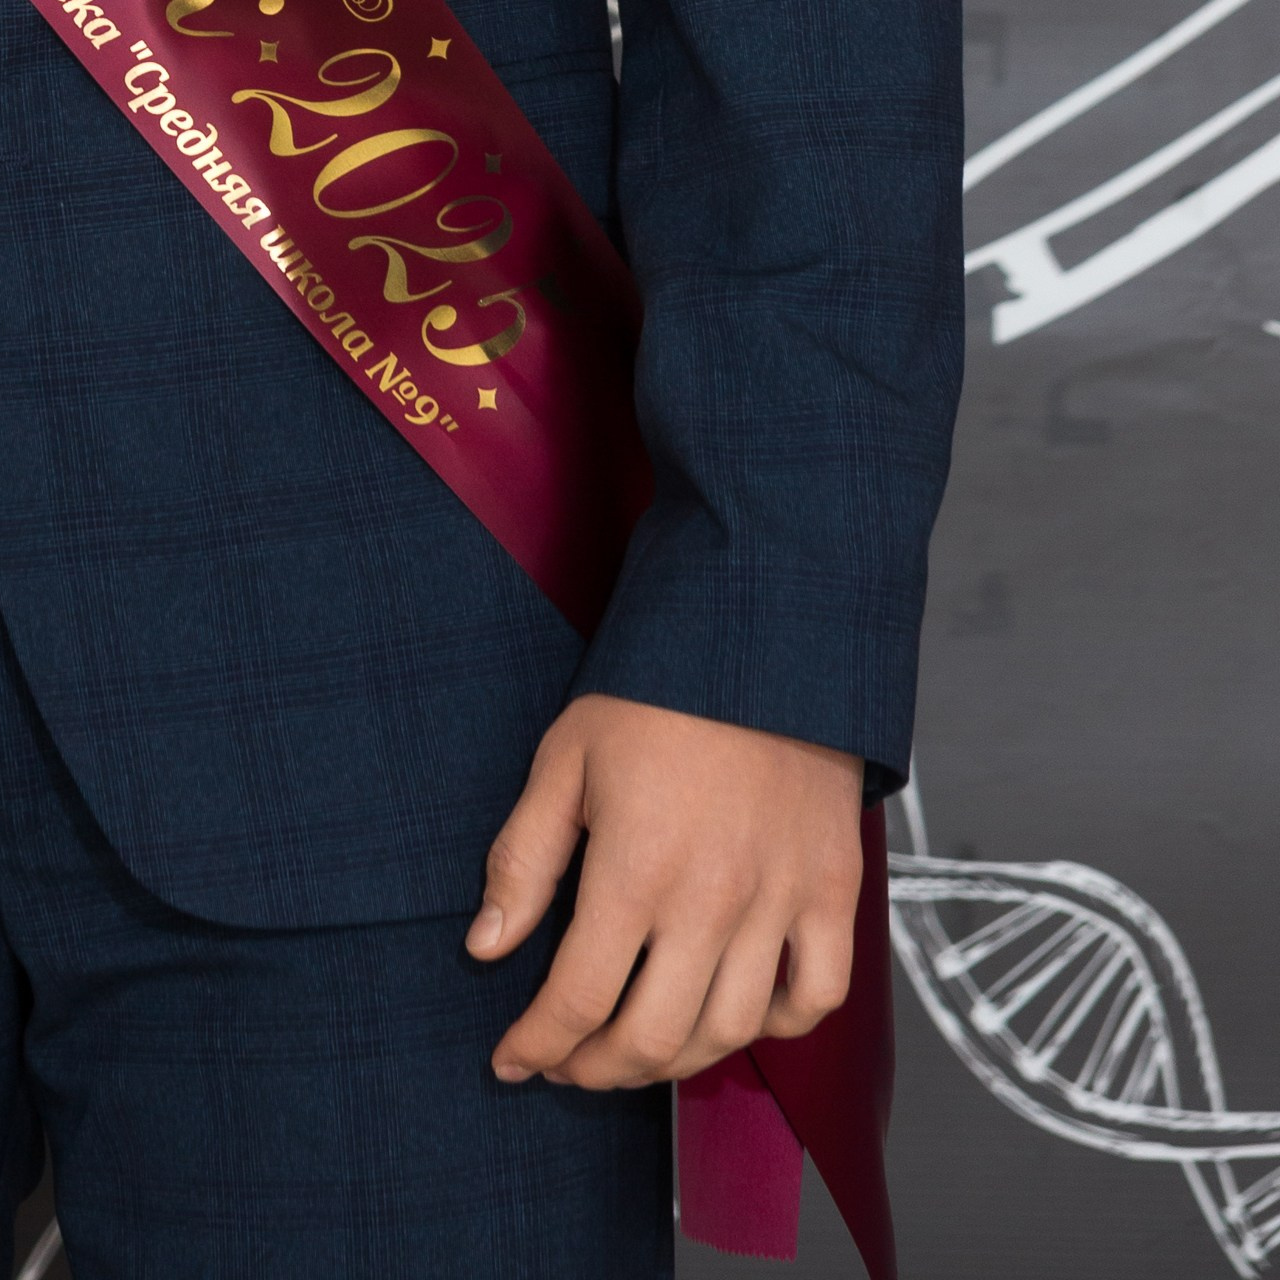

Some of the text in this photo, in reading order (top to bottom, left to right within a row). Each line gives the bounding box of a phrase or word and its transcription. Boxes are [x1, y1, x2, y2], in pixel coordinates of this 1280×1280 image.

[123, 40, 272, 231] "Средняя
[260, 223, 375, 361] школа
[231, 48, 565, 367] 2025
